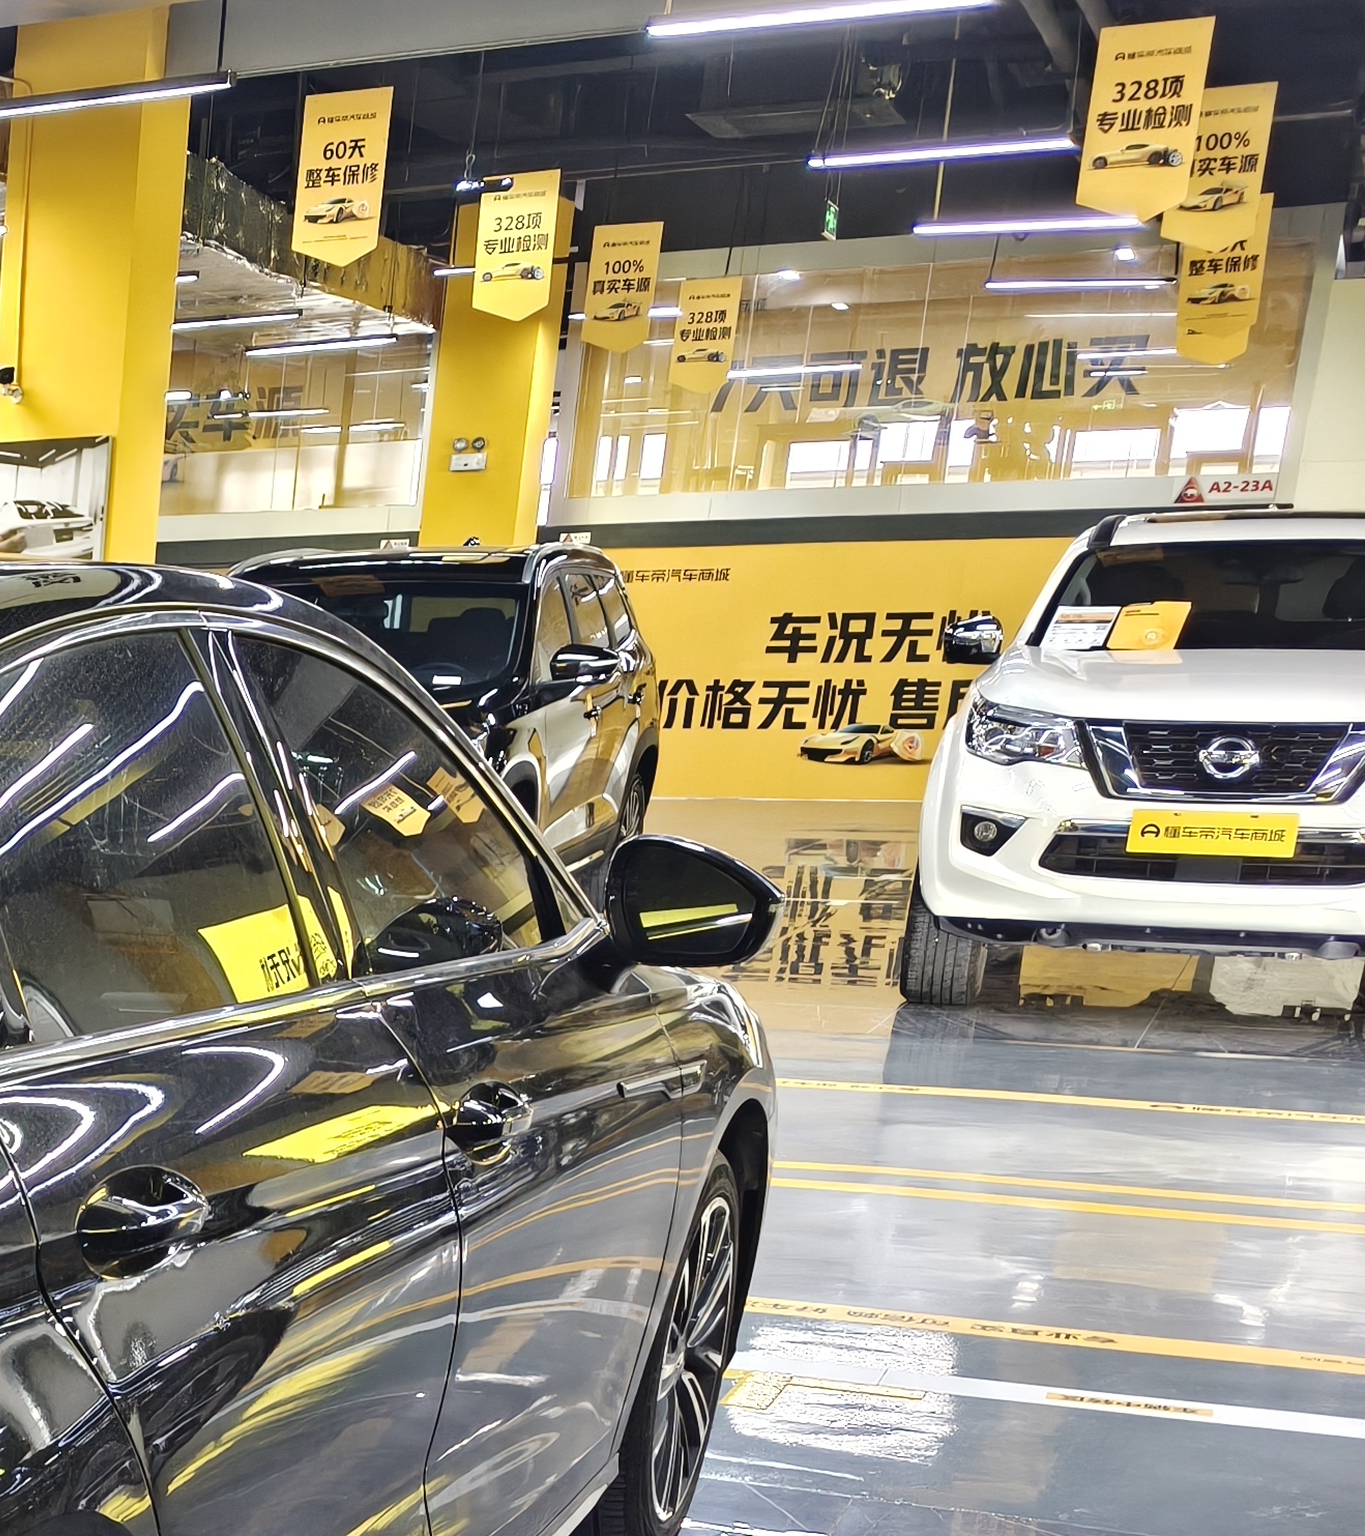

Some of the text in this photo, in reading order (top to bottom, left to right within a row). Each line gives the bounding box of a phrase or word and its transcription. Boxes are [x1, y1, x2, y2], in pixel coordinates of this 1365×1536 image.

[1111, 74, 1186, 103] 328项
[1096, 104, 1193, 134] 专业检测
[322, 138, 366, 160] 60天
[1195, 130, 1251, 152] 100%
[304, 162, 379, 189] 整车保修
[1190, 153, 1260, 178] 实车源
[493, 211, 542, 233] 328项
[483, 233, 549, 255] 专业检测
[604, 259, 645, 275] 100%
[1188, 254, 1260, 277] 整车保修
[592, 277, 651, 295] 真实车源
[687, 310, 727, 325] 328项
[679, 326, 732, 342] 专业检测
[954, 334, 1150, 404] 放心买
[1209, 479, 1273, 494] A2-23A
[765, 610, 992, 665] 车况无
[658, 678, 867, 730] 价格无忧
